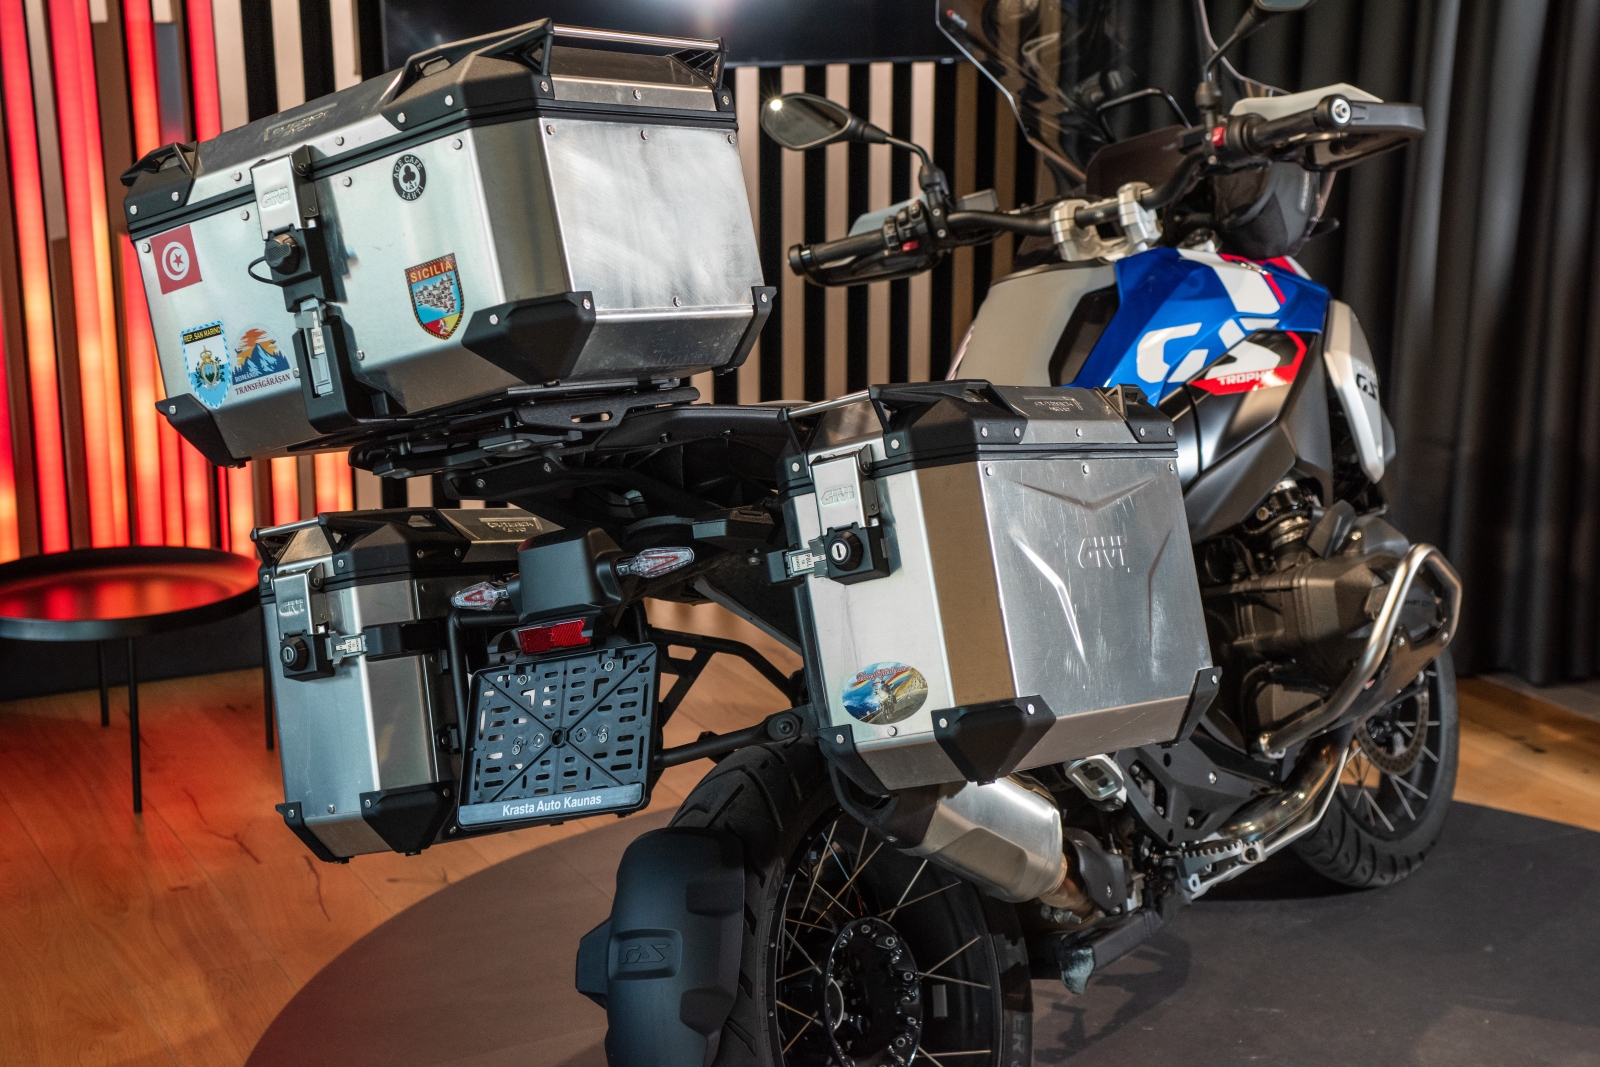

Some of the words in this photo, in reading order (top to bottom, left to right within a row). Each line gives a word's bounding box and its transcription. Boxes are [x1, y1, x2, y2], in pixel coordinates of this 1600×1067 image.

[394, 160, 404, 178] ACE
[404, 156, 422, 170] CAFE
[261, 186, 290, 208] GIVI
[401, 184, 424, 200] LAHTI
[410, 260, 453, 283] SICILIA
[183, 334, 194, 342] REP.
[194, 330, 204, 340] SAN
[203, 326, 221, 337] MARINO
[1136, 318, 1281, 384] GS
[1217, 371, 1270, 386] TROPH
[820, 484, 855, 506] GIVI
[1077, 535, 1126, 569] GIVI
[502, 804, 535, 817] Krasta
[536, 800, 561, 813] Auto
[563, 795, 602, 809] Kaunas
